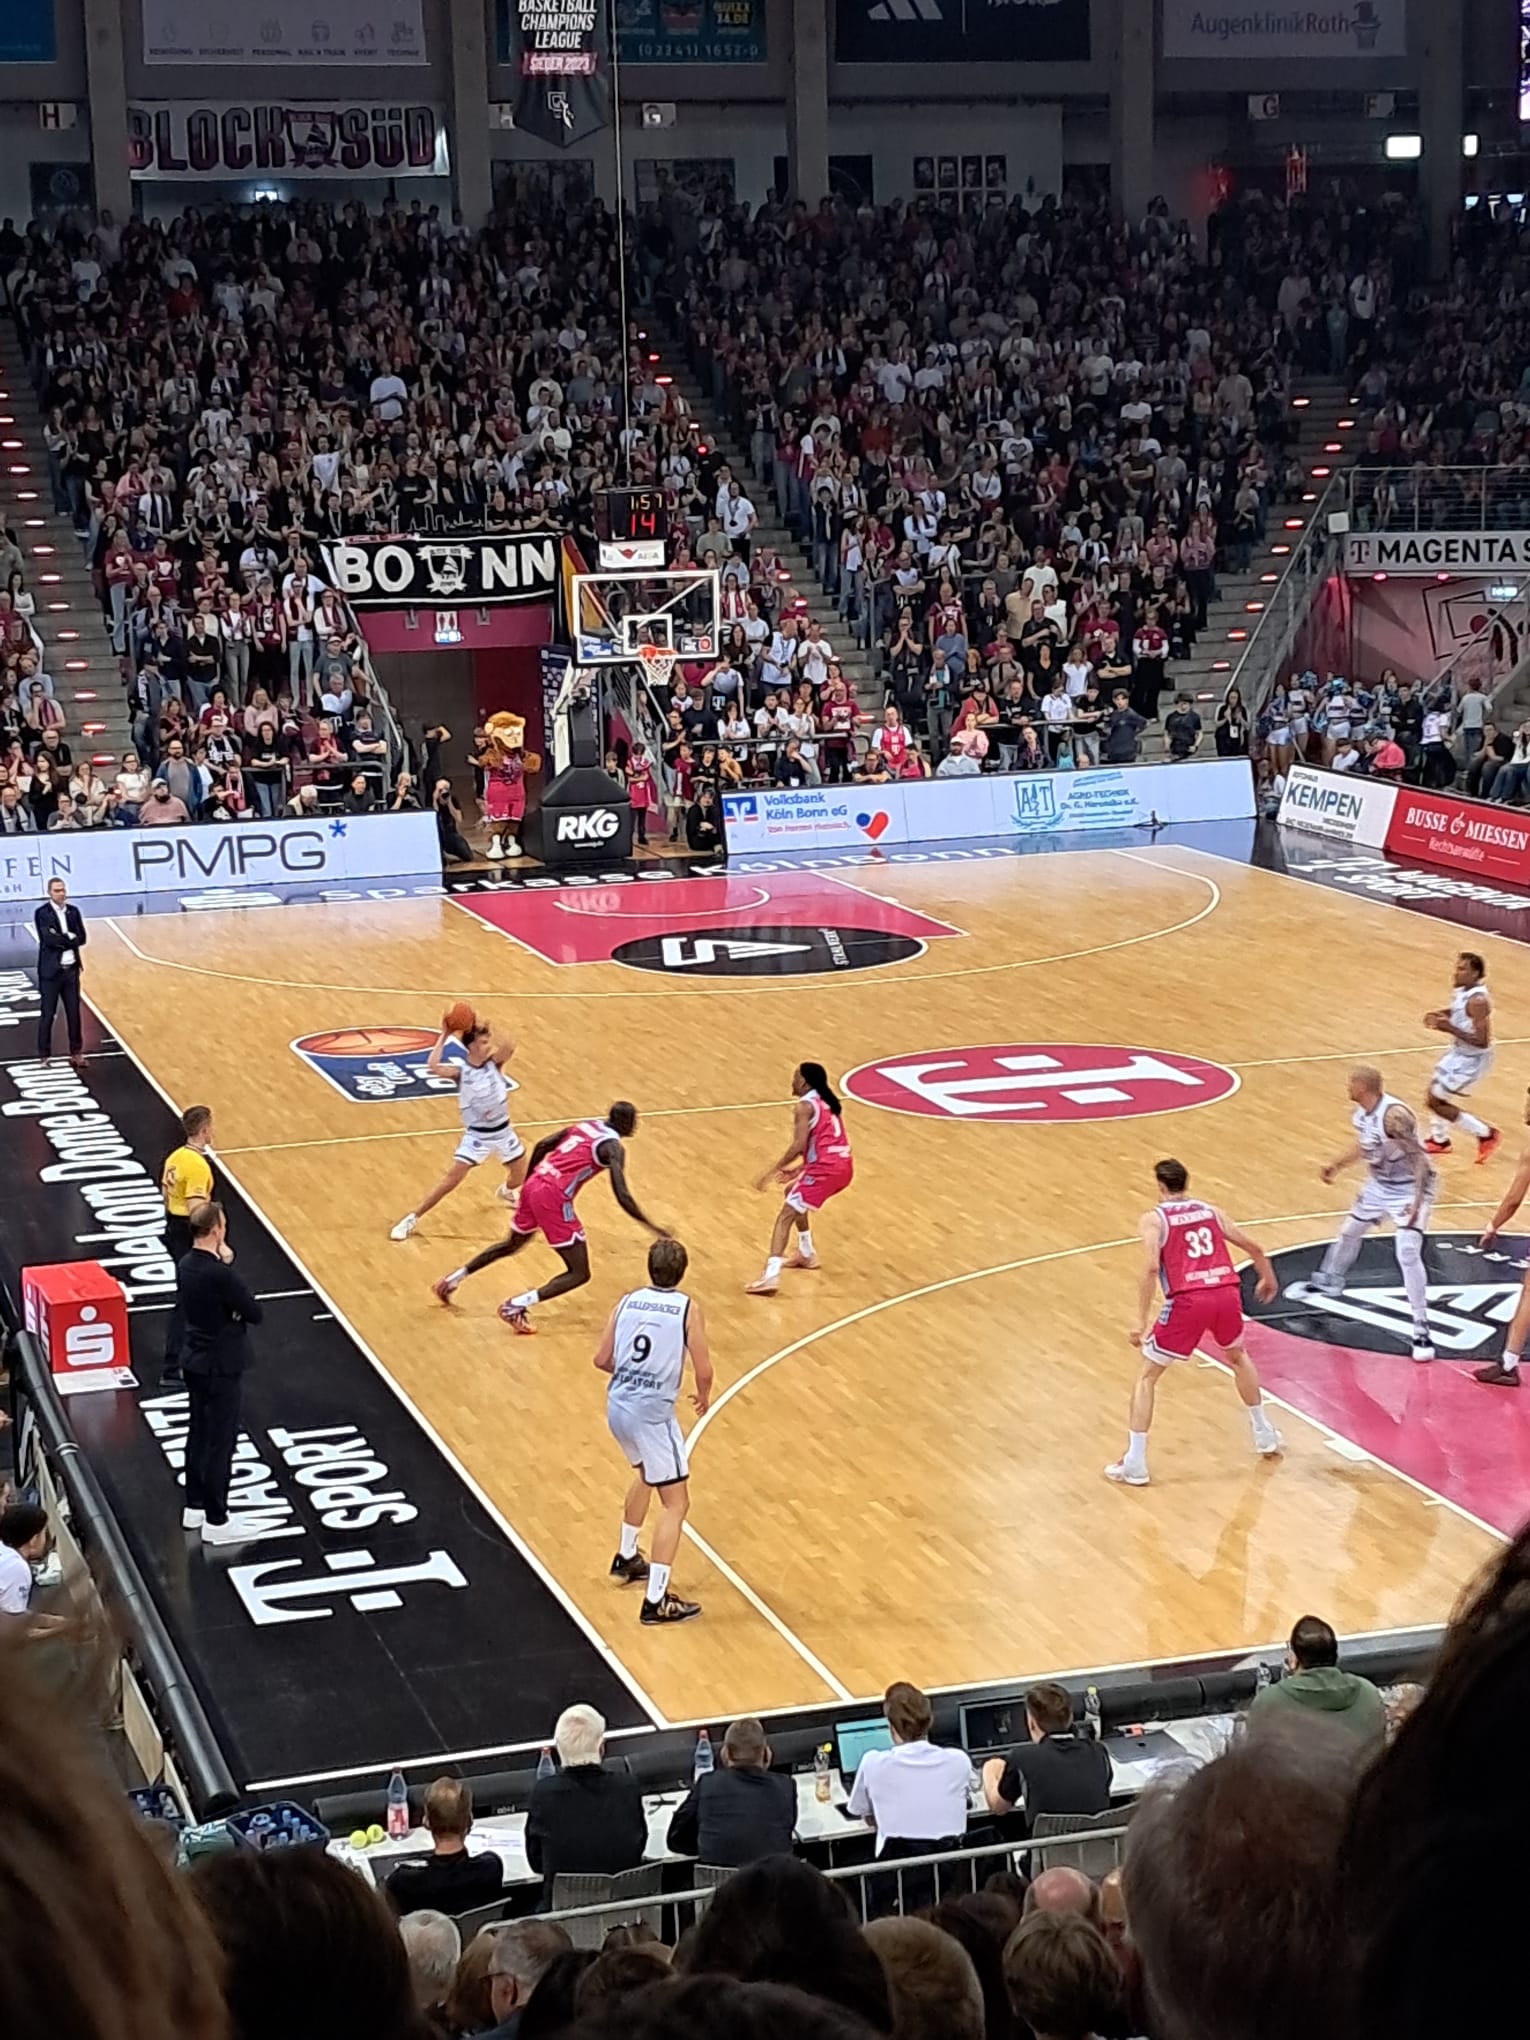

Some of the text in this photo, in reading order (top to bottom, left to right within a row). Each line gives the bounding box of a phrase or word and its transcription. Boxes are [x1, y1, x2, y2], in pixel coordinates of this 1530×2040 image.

[518, 0, 598, 13] BASKETBALL
[521, 13, 595, 31] CHAMPIONS
[535, 31, 583, 49] LEAGUE
[128, 105, 436, 170] BLOCK SÜD
[630, 512, 656, 537] 14
[1377, 538, 1518, 564] MAGENTA
[764, 792, 827, 806] Volksbank
[765, 804, 848, 821] Köln Bonn eG
[1285, 781, 1363, 821] KEMPEN
[556, 808, 620, 842] RKG
[1404, 806, 1449, 833] BUSSE
[1464, 819, 1530, 851] MIESSEN
[1, 1060, 178, 1305] Telekom Dome Bonn
[1184, 1226, 1215, 1259] 33
[630, 1333, 652, 1364] 9
[266, 1425, 418, 1529] SPORT
